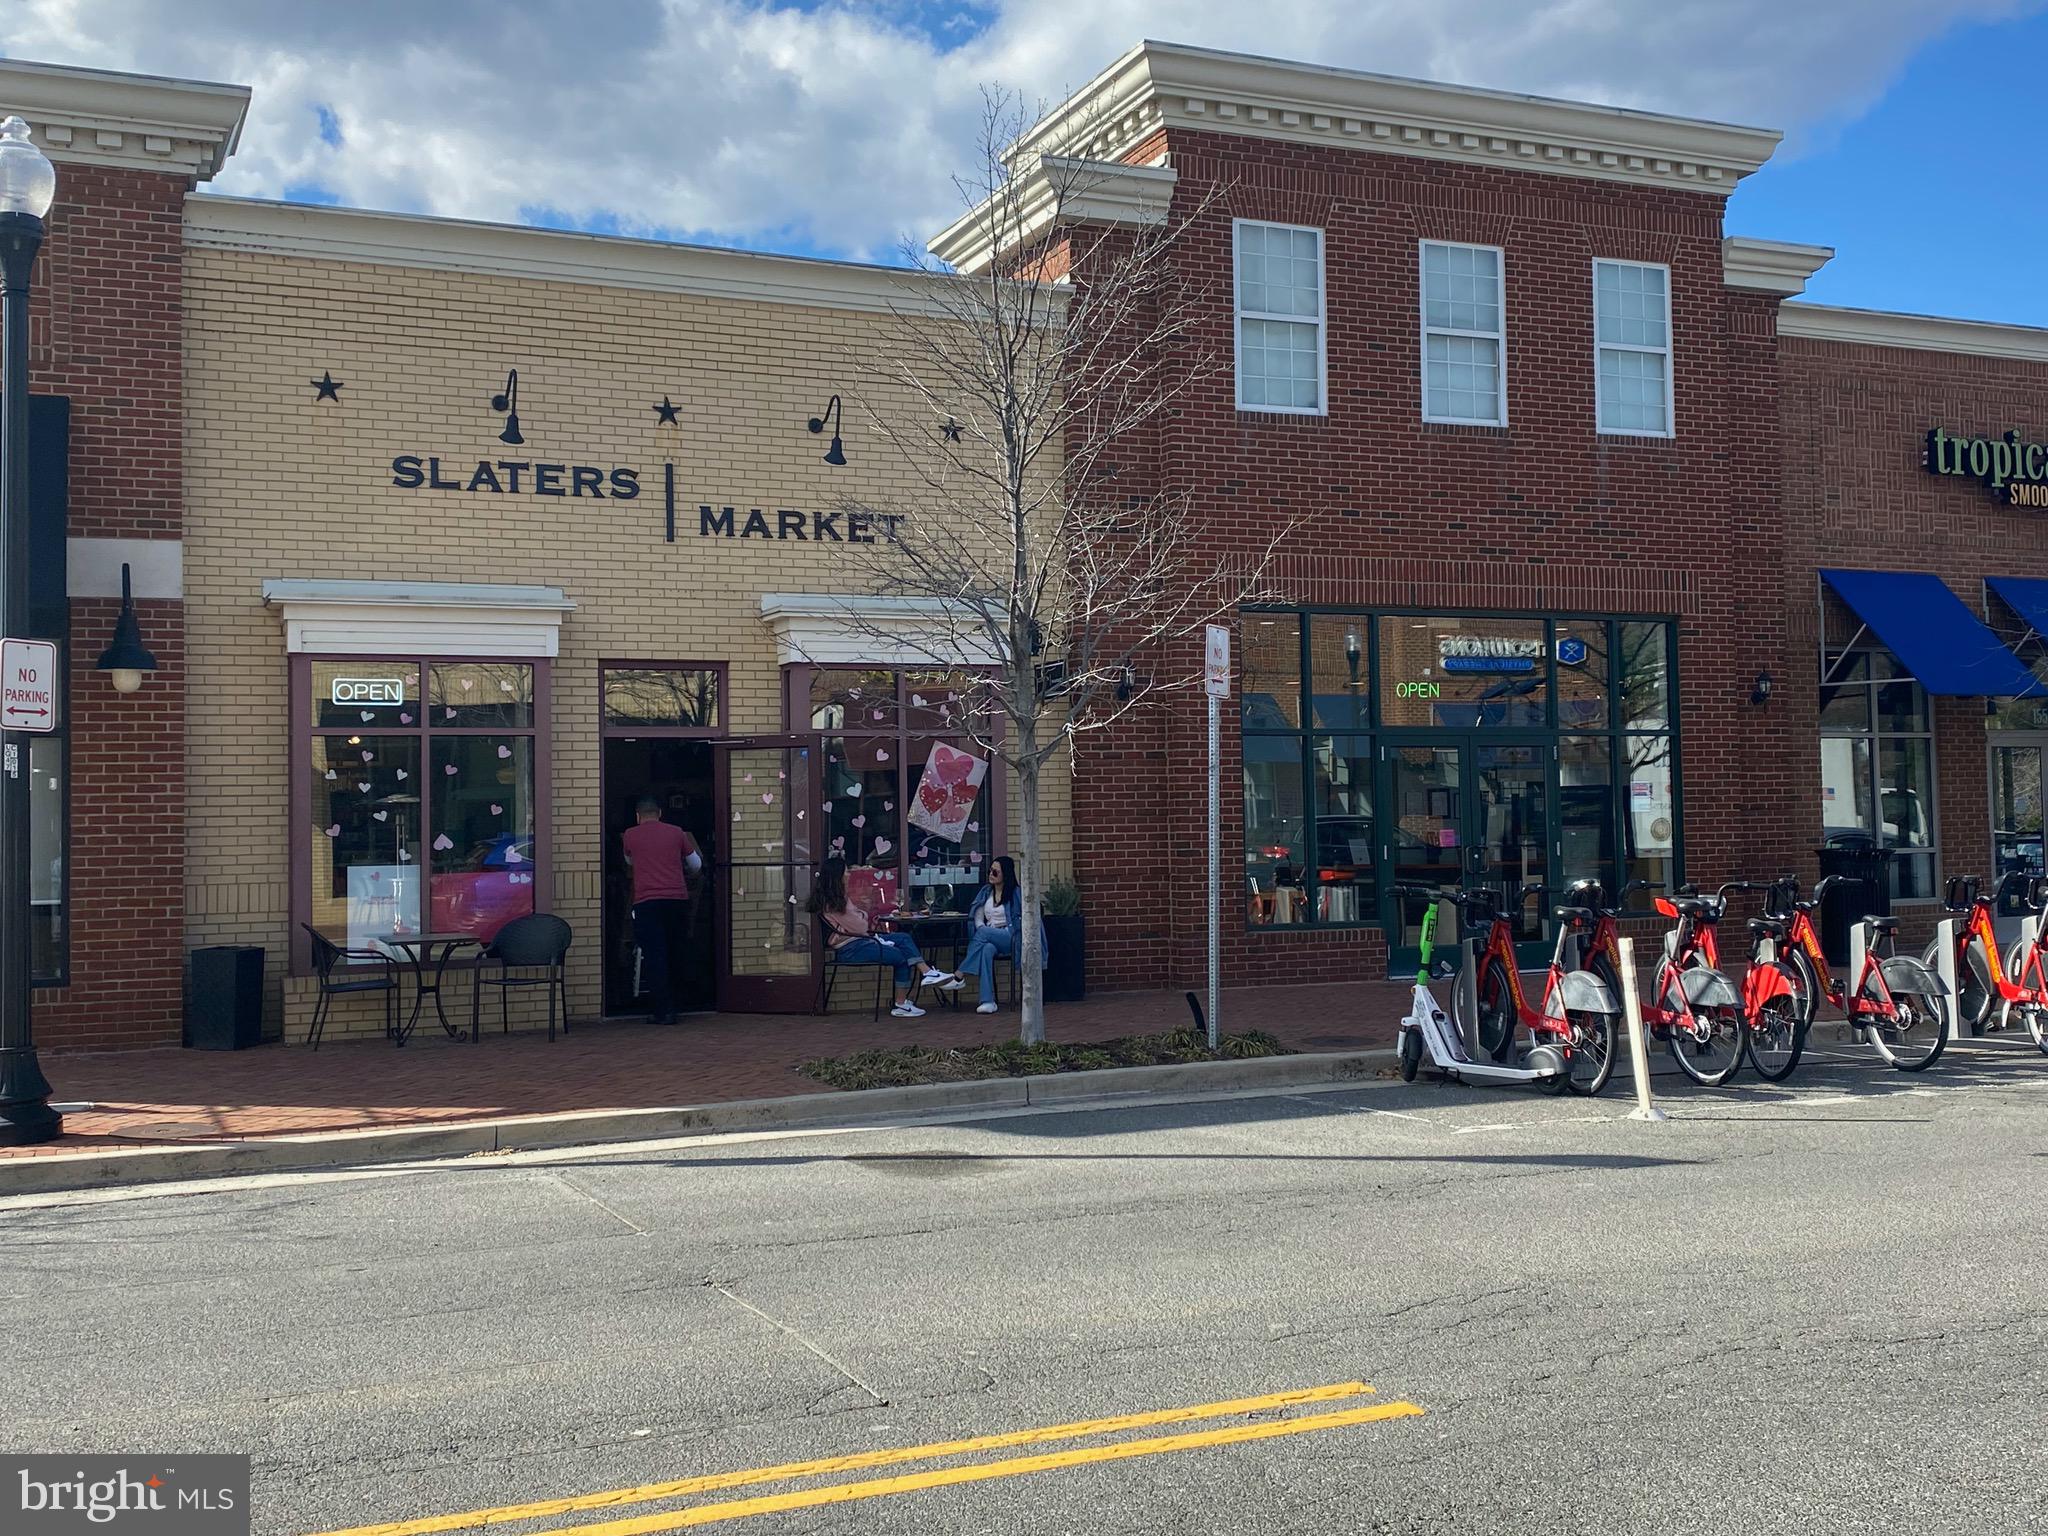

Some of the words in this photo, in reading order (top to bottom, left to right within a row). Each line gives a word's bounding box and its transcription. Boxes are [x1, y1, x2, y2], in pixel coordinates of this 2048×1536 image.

[1934, 426, 2048, 488] tropic
[392, 455, 641, 499] SLATERS
[699, 506, 904, 543] MARKET
[18, 668, 37, 683] NO
[5, 688, 49, 704] PARKING
[336, 683, 399, 700] OPEN
[1396, 682, 1440, 698] OPEN
